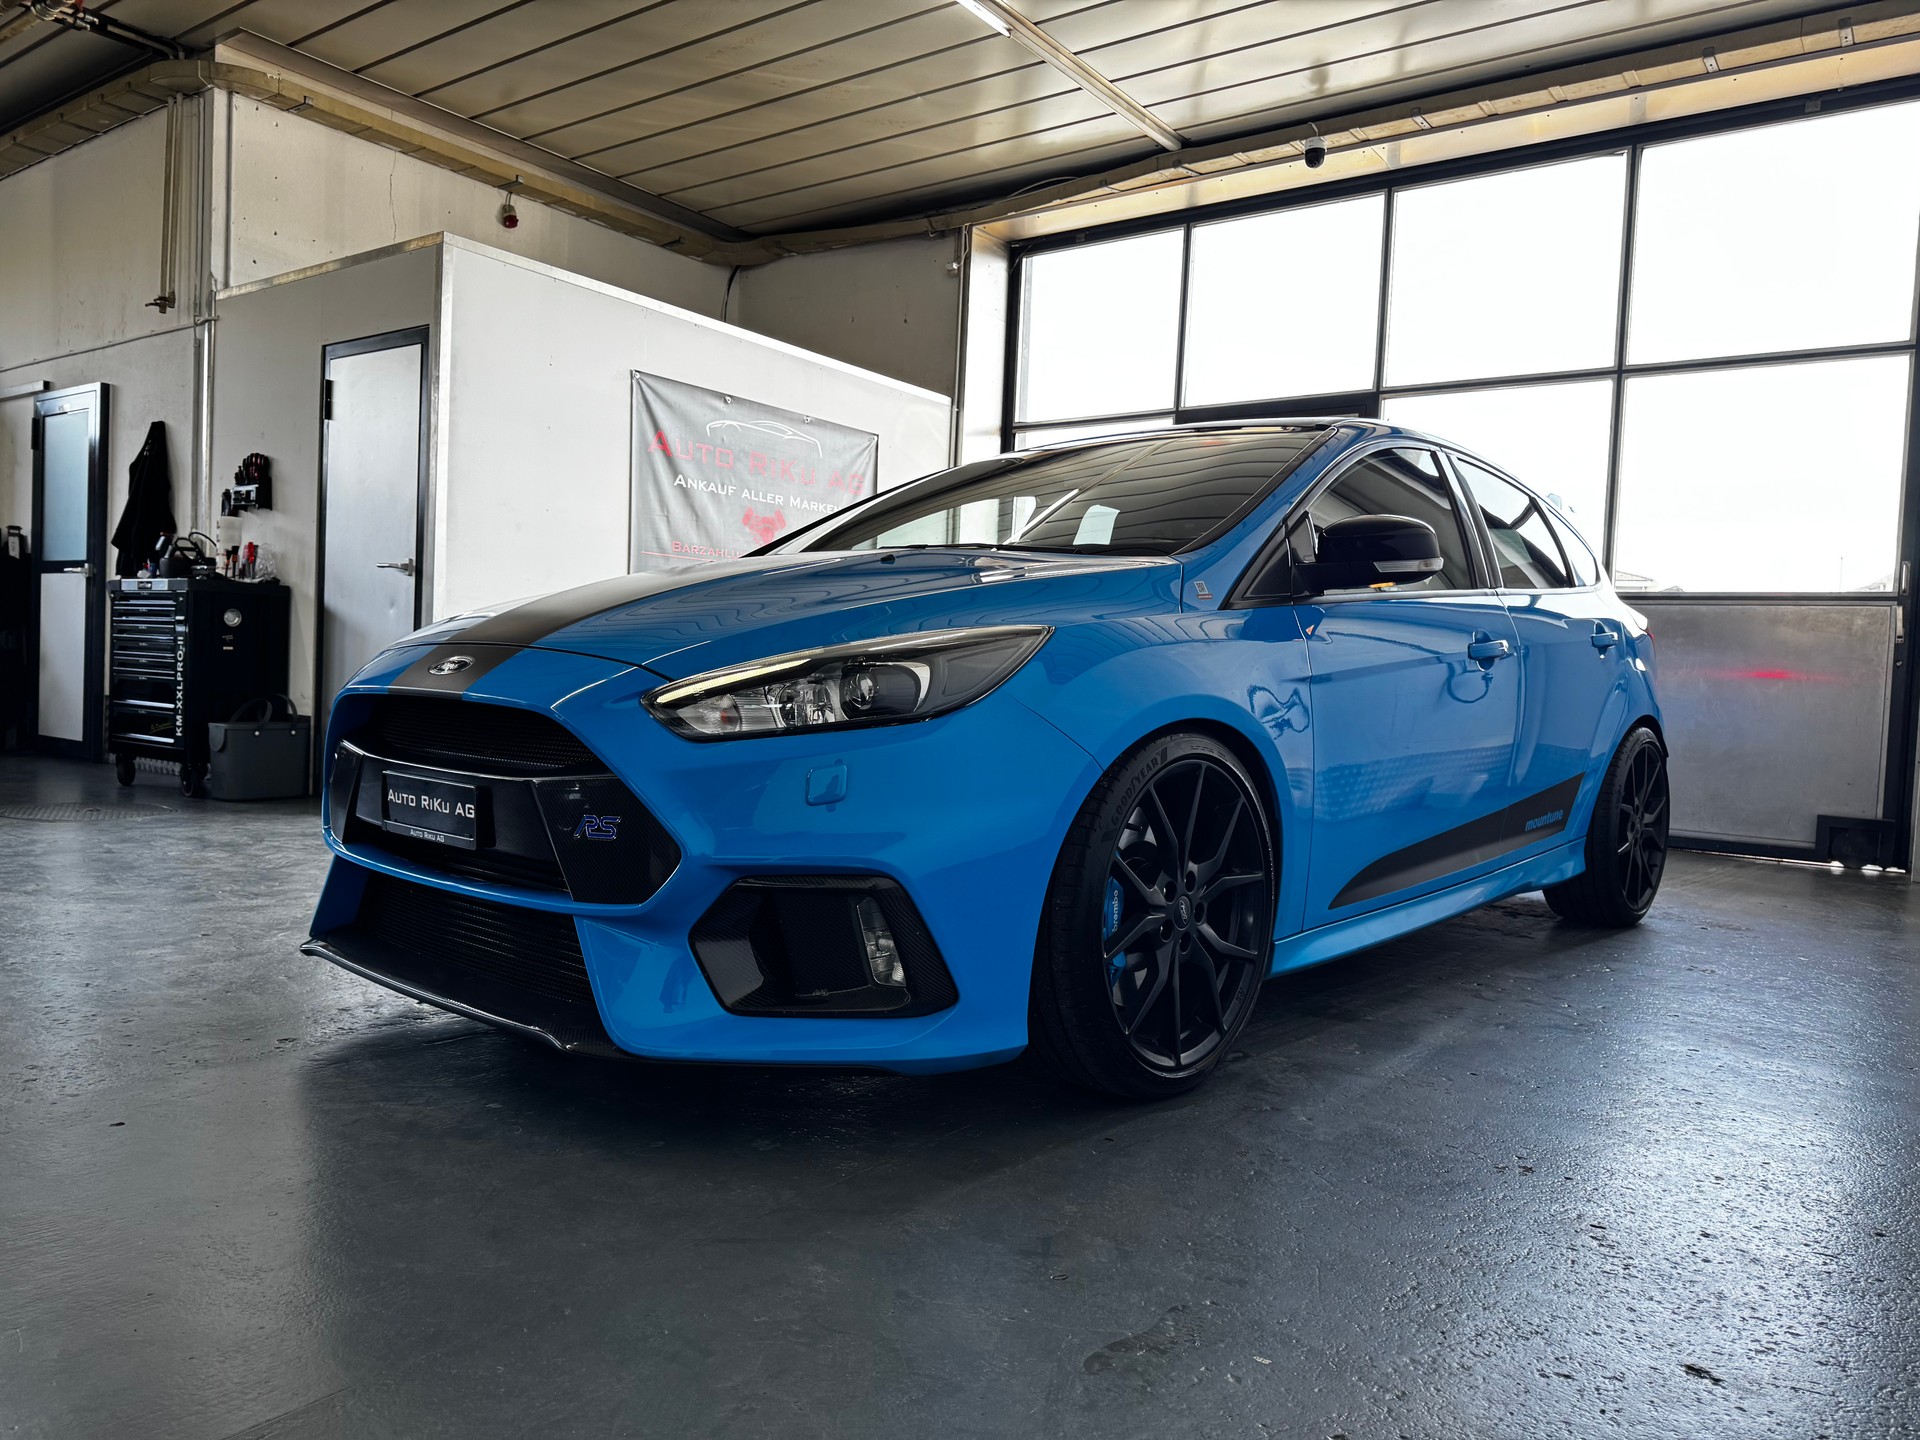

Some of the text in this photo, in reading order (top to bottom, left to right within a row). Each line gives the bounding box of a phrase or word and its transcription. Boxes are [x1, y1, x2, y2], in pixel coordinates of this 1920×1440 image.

[673, 475, 737, 496] ANKAUF
[741, 488, 784, 506] ALLER
[827, 470, 865, 496] AG
[671, 541, 743, 560] BARZAHLU
[454, 802, 475, 819] AG
[573, 814, 621, 840] RS
